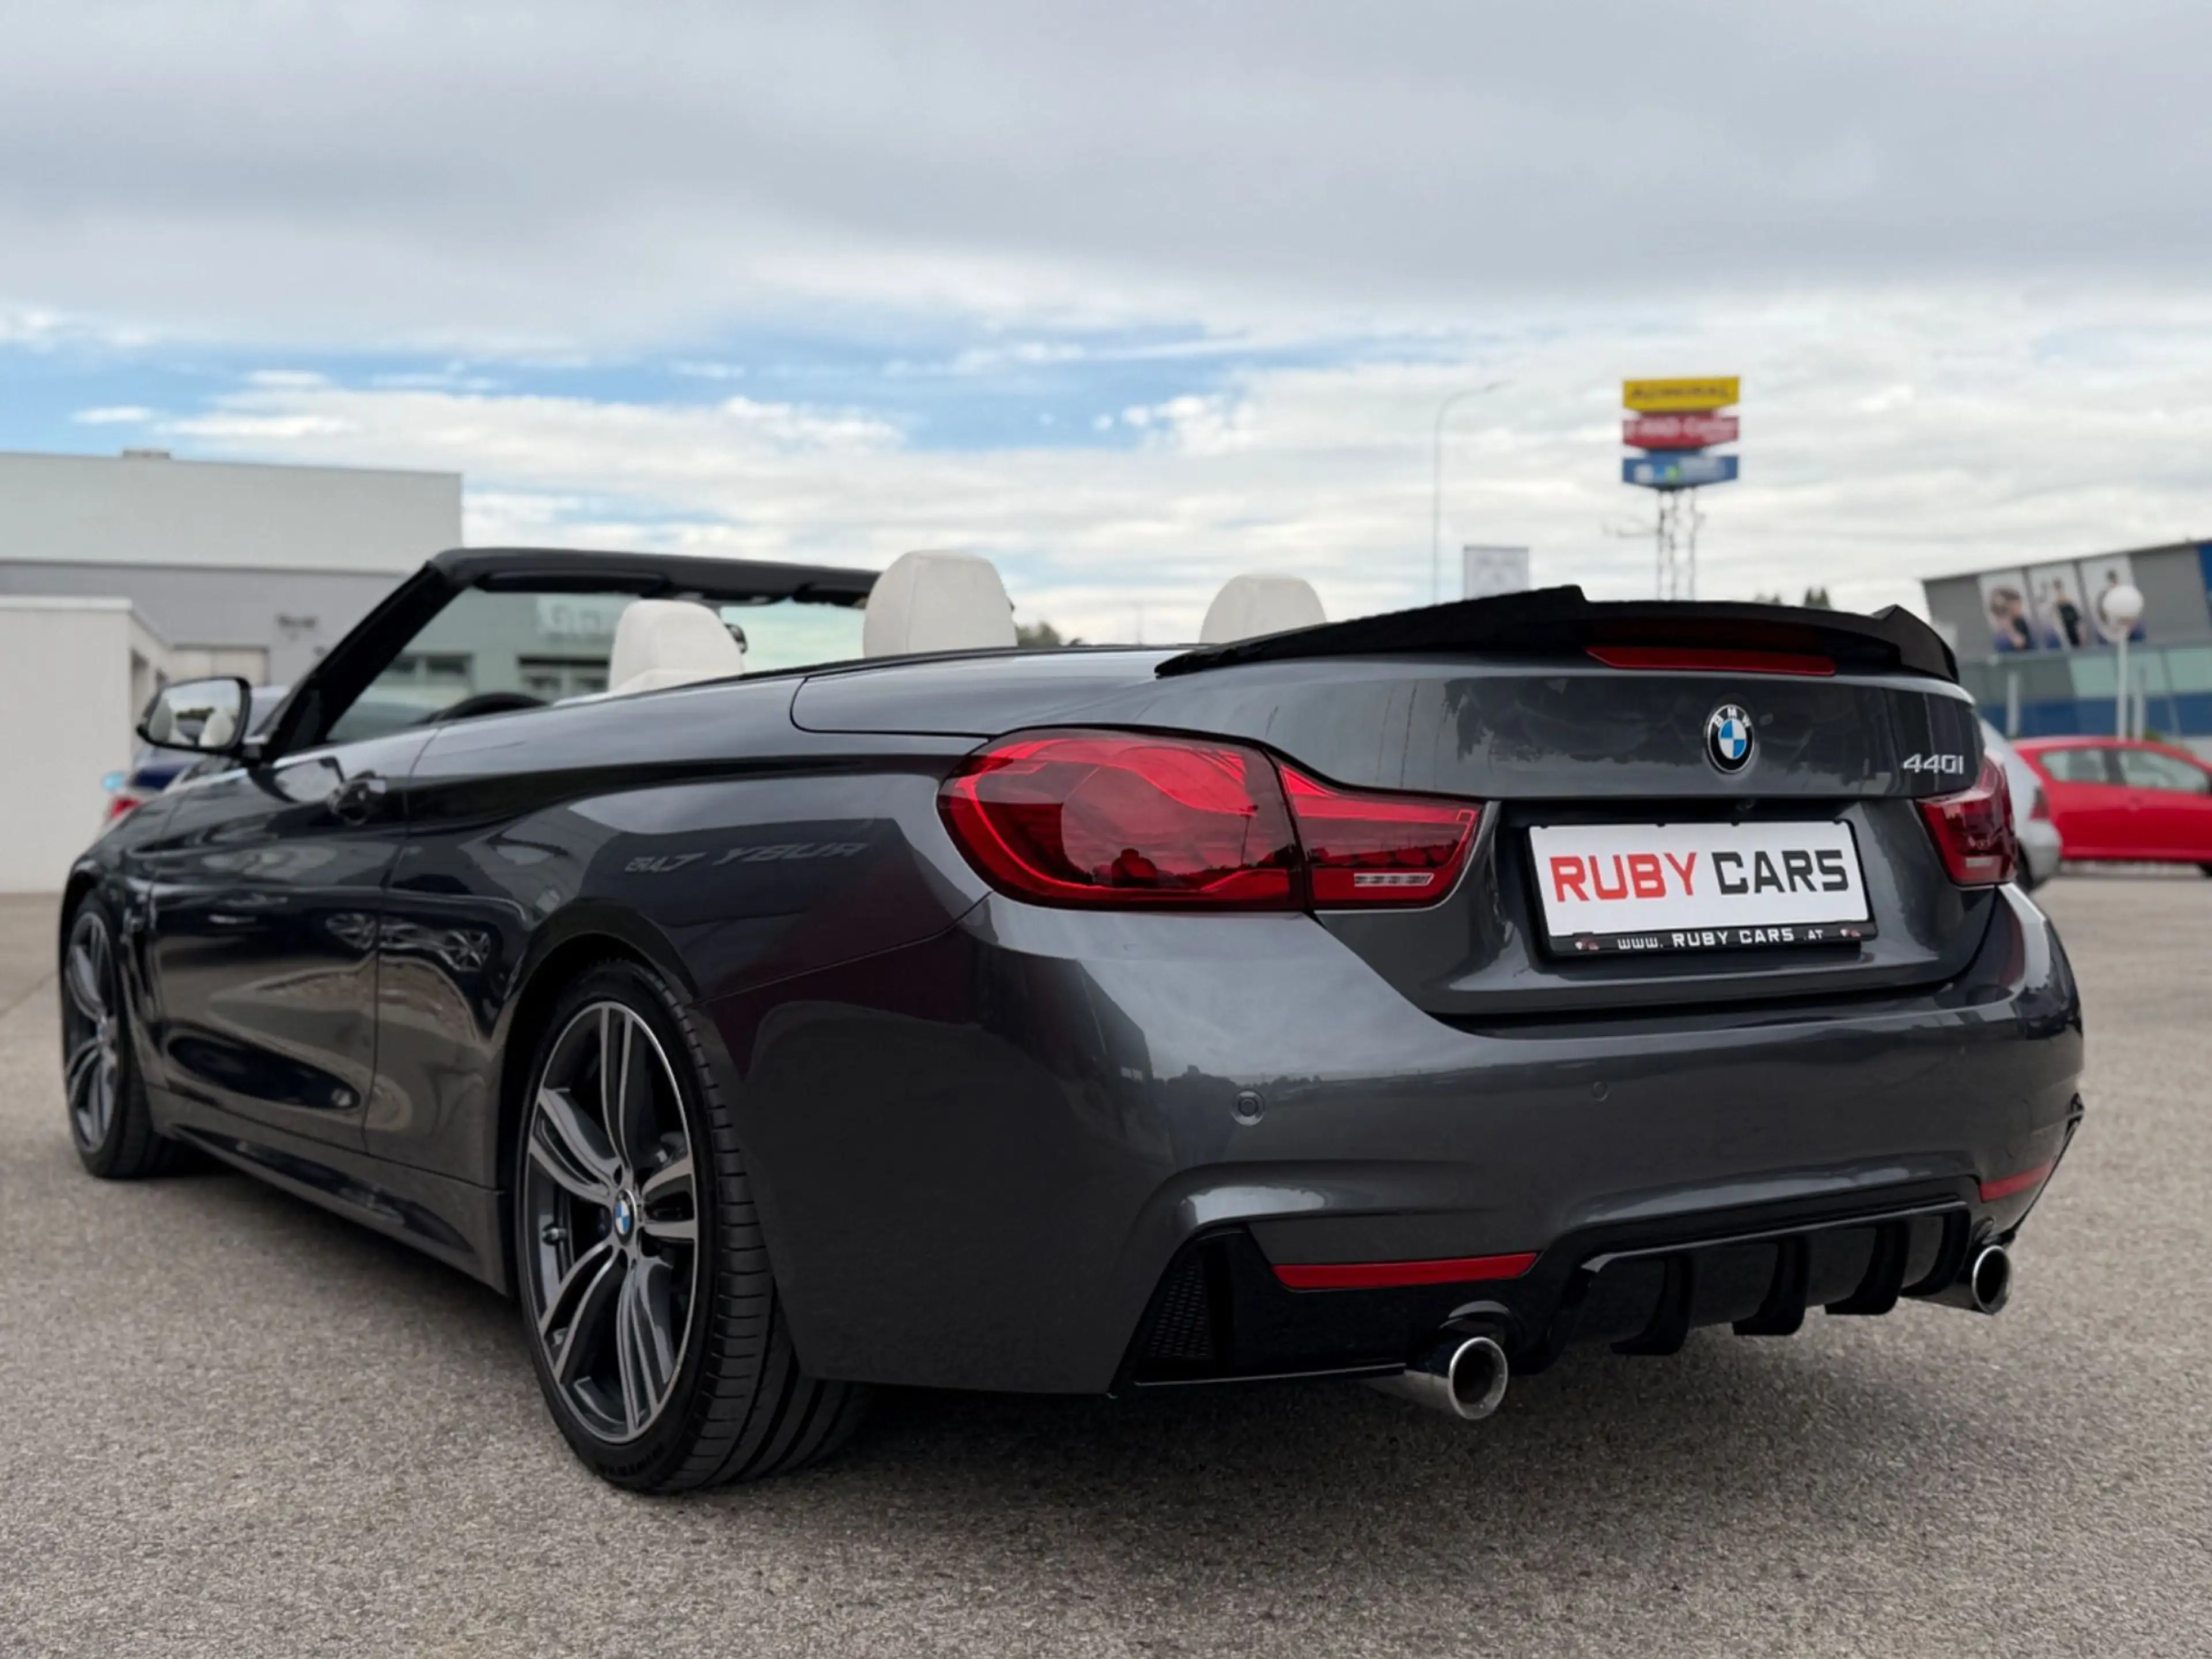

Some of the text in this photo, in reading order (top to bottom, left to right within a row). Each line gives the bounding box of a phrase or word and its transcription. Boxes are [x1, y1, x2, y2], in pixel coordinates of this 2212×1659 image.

[1549, 849, 1849, 903] RUBY CARS
[1671, 930, 1728, 948] RUBY
[1738, 927, 1795, 944] CARS
